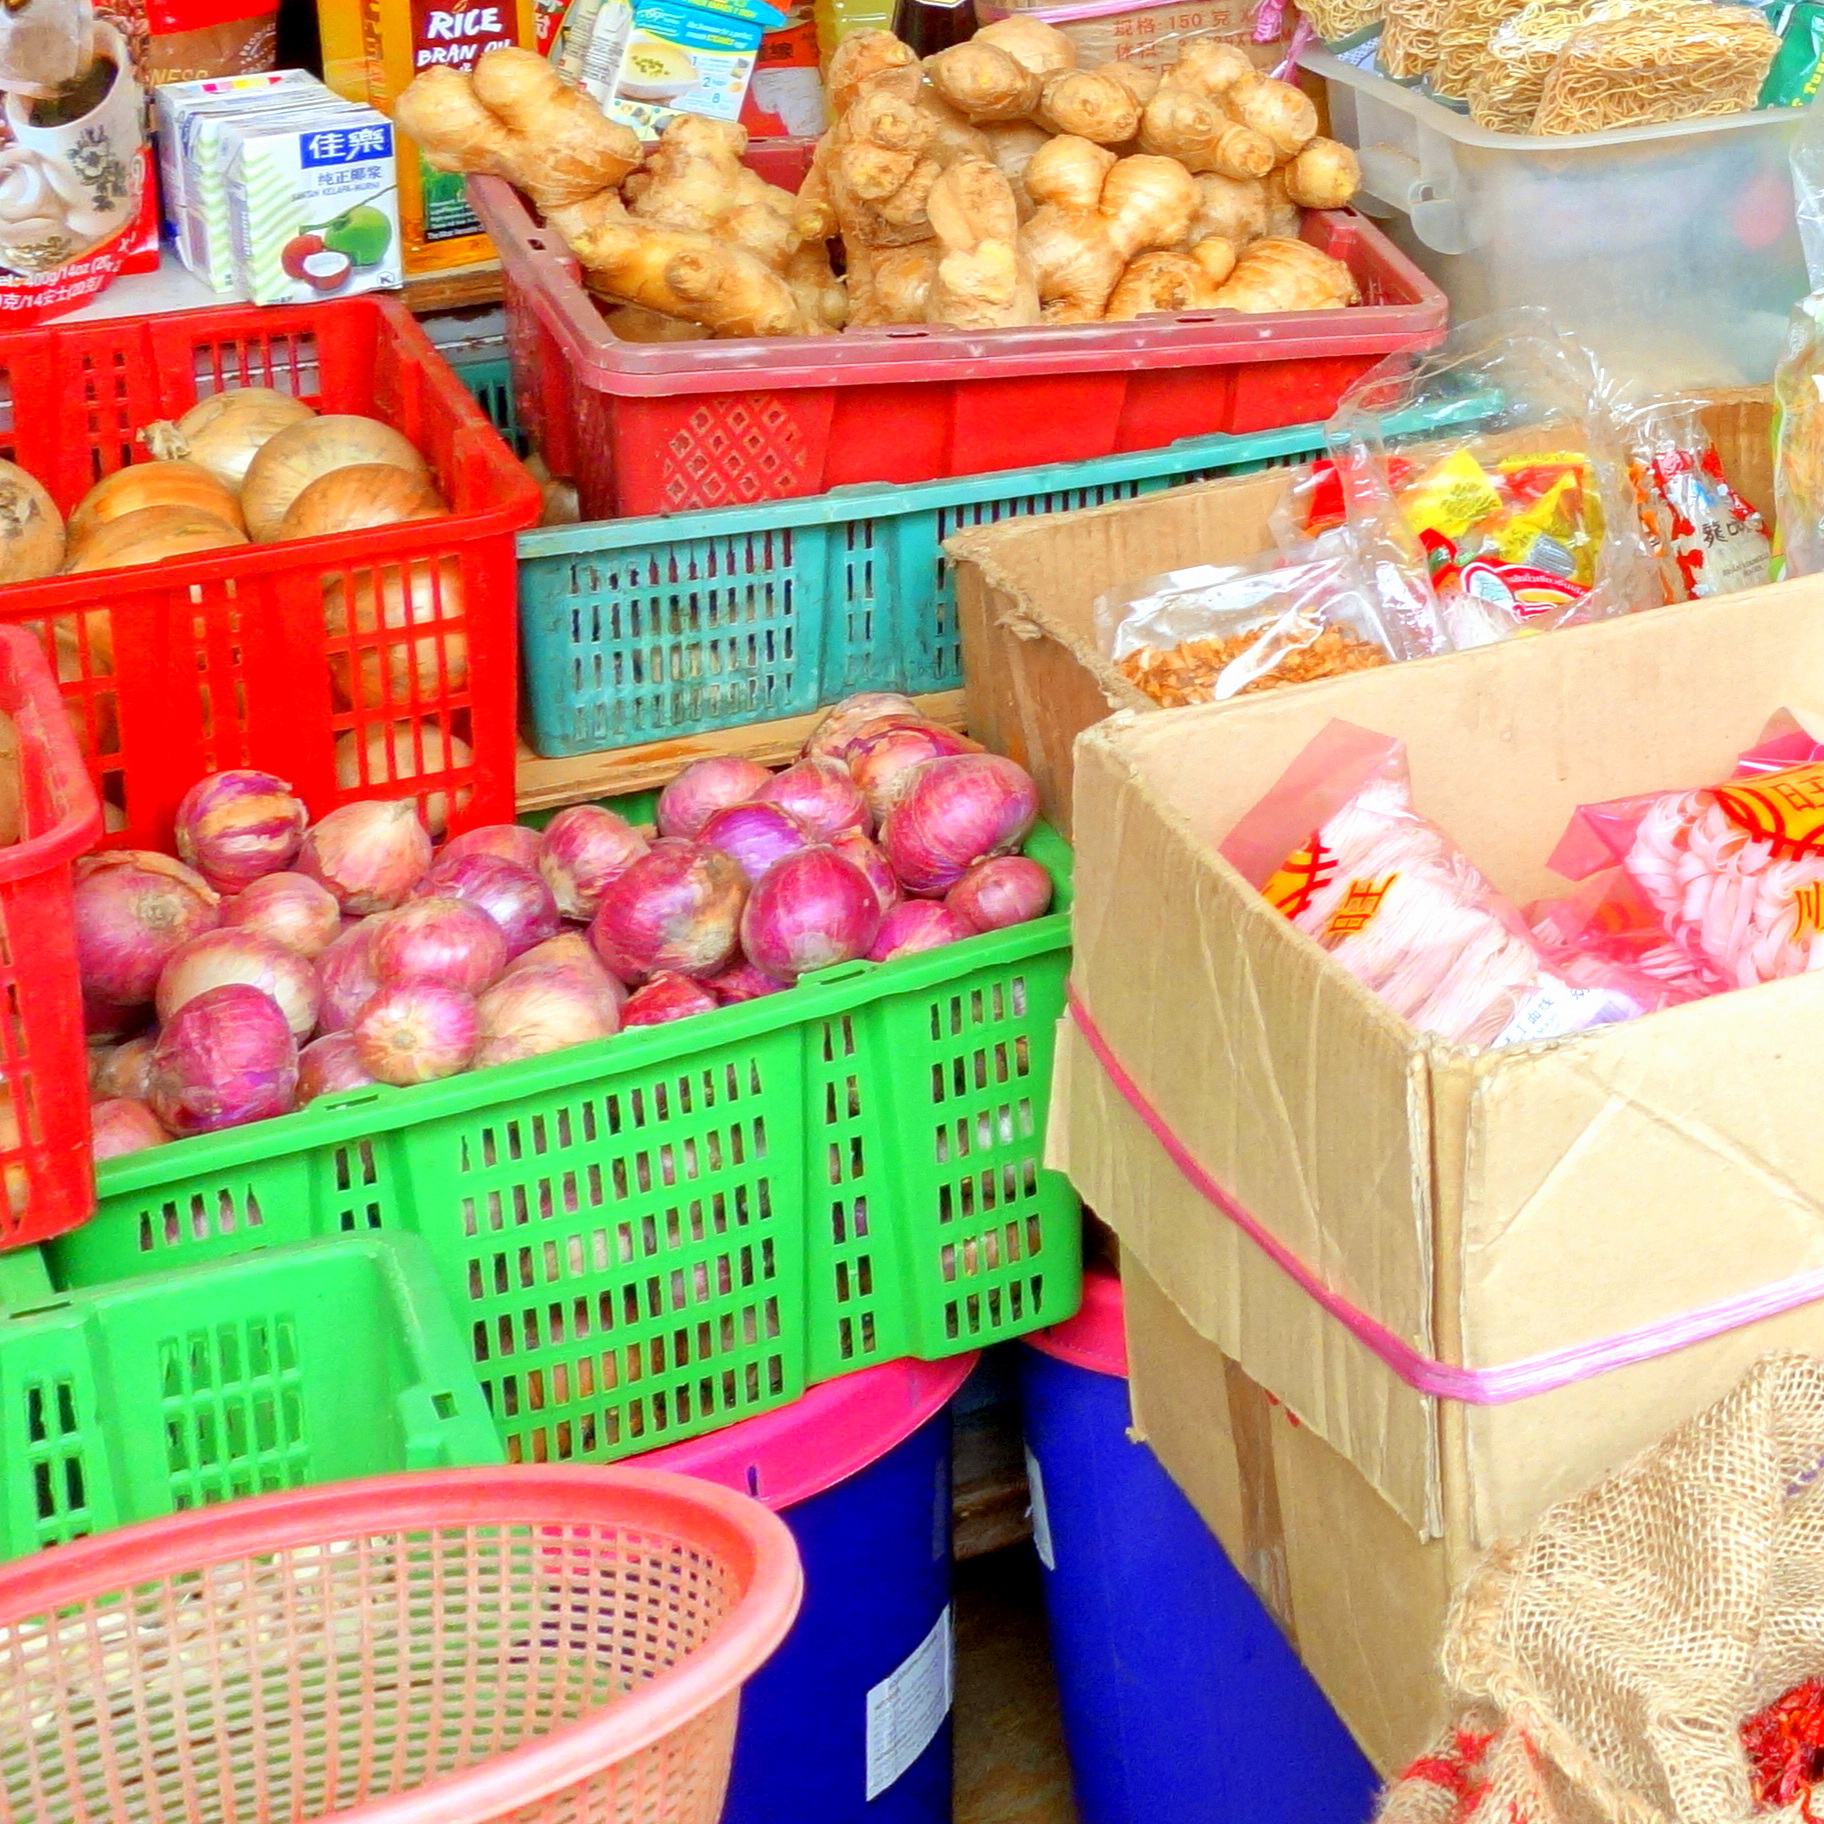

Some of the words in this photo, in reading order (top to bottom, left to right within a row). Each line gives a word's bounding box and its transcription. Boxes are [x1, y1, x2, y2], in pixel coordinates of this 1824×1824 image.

[428, 5, 503, 40] RICE
[1168, 13, 1201, 30] 150
[418, 43, 472, 68] BRAN
[309, 126, 384, 162] 佳樂
